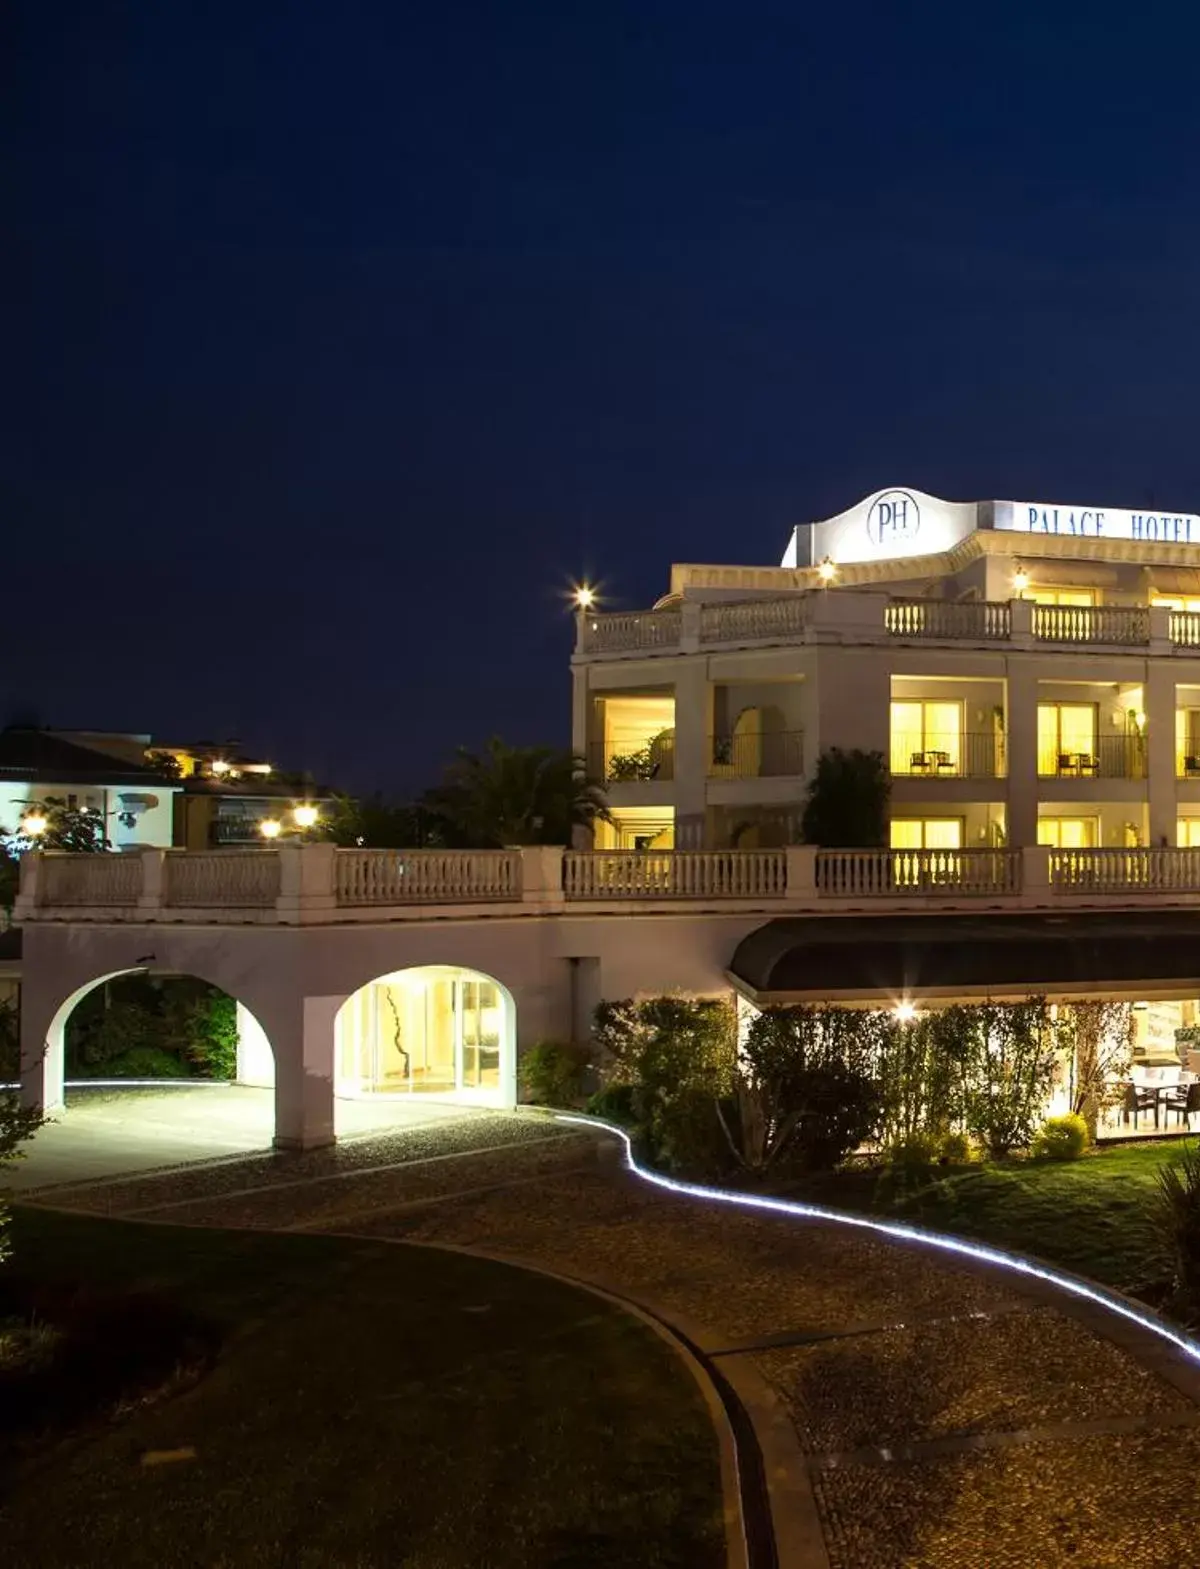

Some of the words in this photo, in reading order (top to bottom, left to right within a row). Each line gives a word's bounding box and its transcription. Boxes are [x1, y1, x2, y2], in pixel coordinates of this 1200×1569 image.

[878, 500, 908, 543] PH
[1028, 506, 1104, 537] PALACE
[1131, 514, 1191, 543] HOTEL
